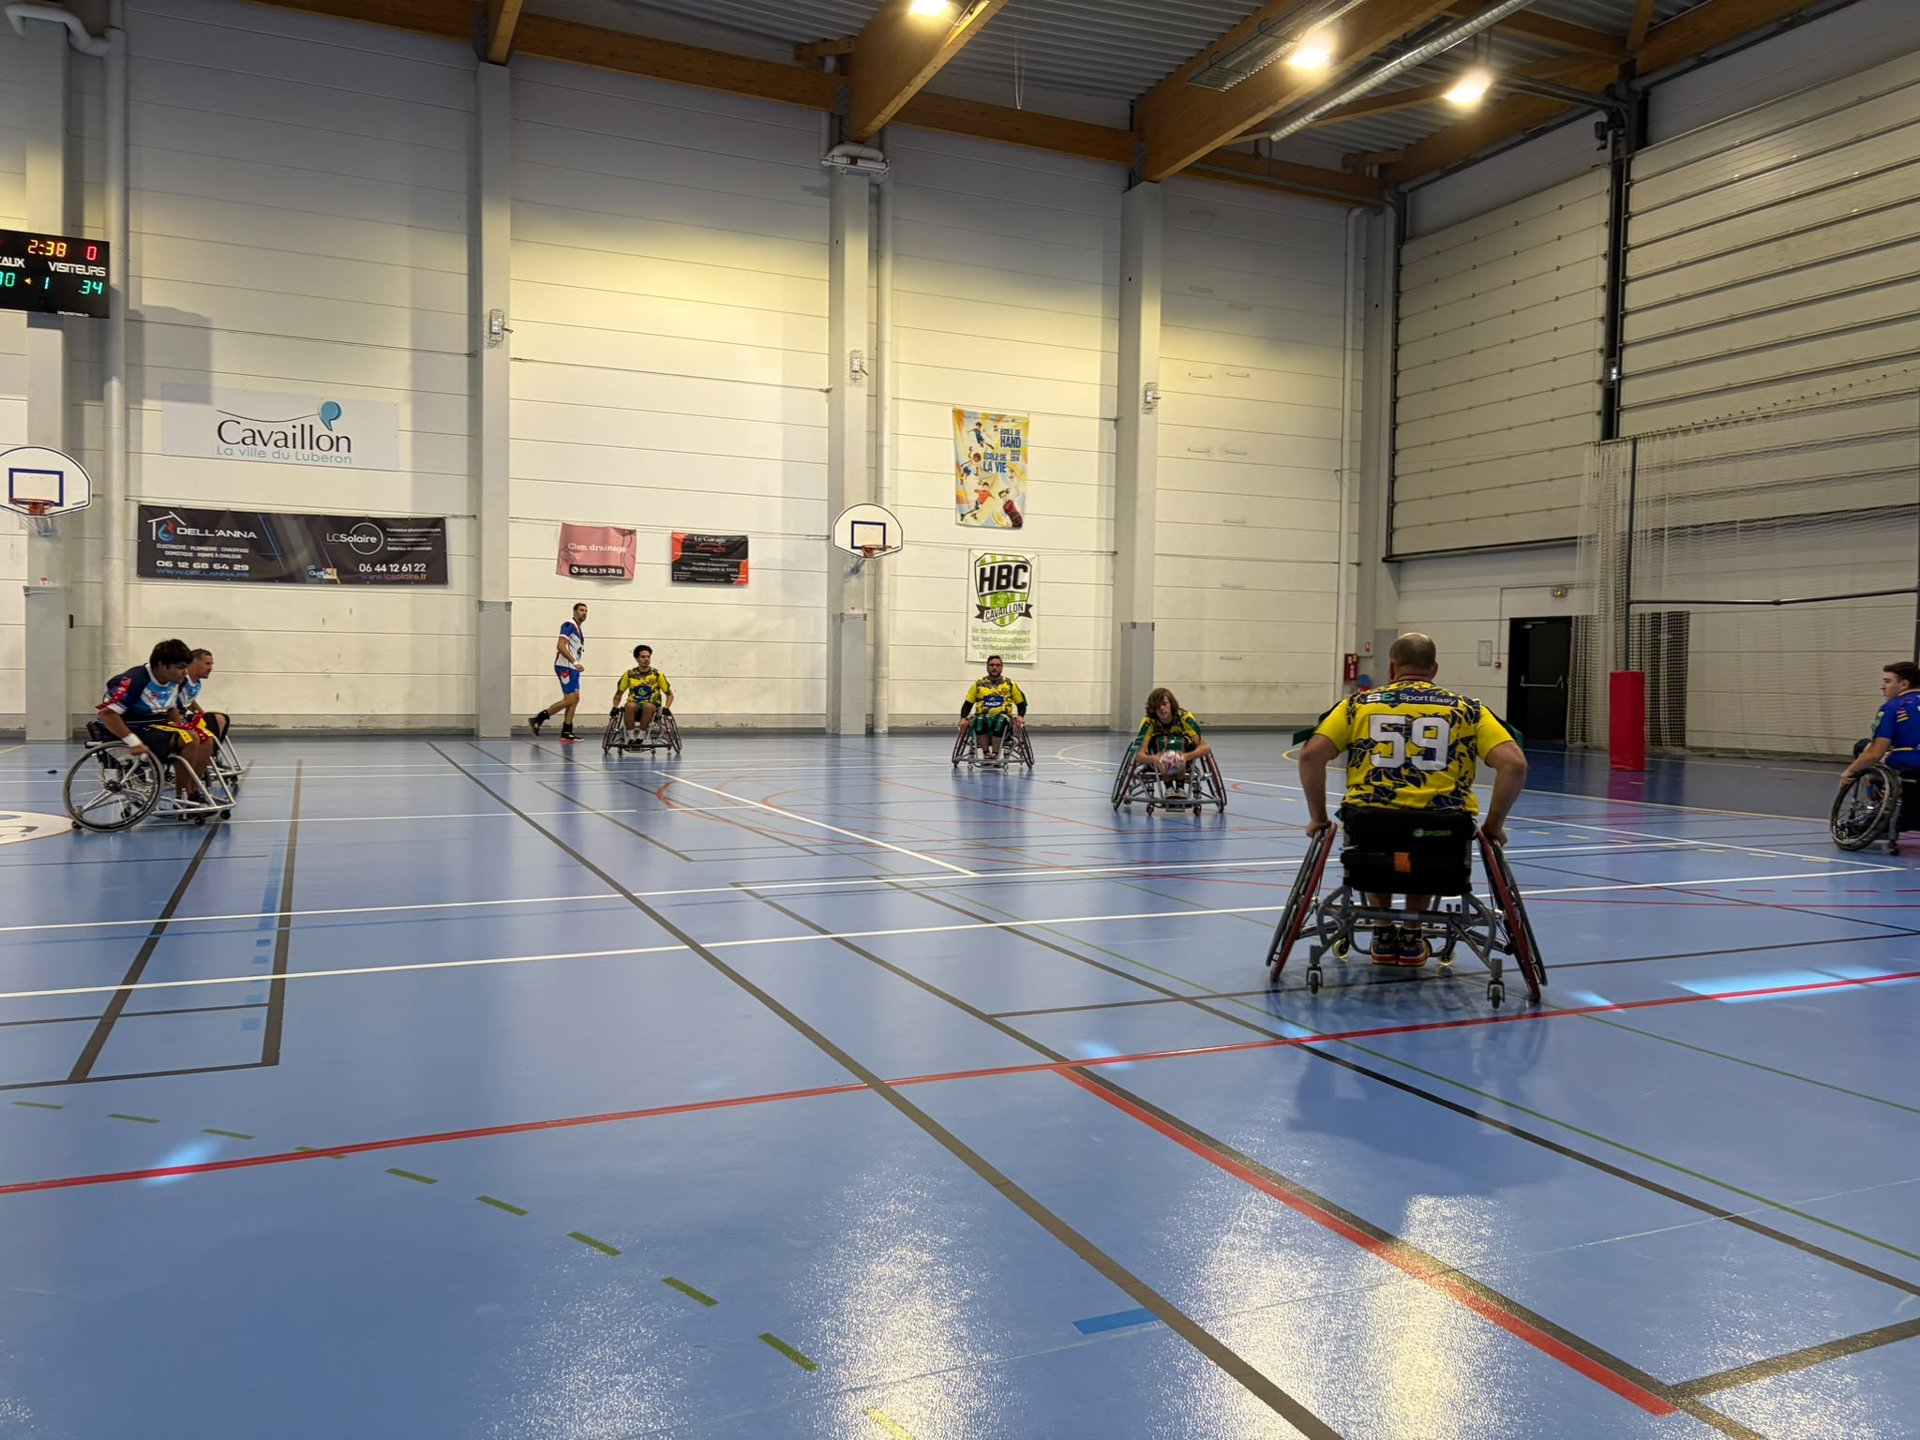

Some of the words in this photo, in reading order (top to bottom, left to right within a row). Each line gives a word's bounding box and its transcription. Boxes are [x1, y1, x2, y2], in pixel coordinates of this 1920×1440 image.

[28, 239, 67, 257] 2:38
[86, 246, 97, 260] 0
[48, 261, 106, 277] VISITEURS
[44, 276, 50, 290] 1
[79, 280, 103, 294] 34
[217, 419, 352, 453] Cavaillon
[1000, 436, 1021, 448] HAND
[217, 446, 233, 456] La
[239, 448, 266, 458] ville
[272, 450, 290, 460] du
[296, 450, 352, 464] Luberon
[983, 461, 993, 472] LA
[995, 462, 1007, 473] VIE
[176, 527, 258, 540] DELL'ANNA
[326, 532, 377, 544] LCSolaire
[590, 544, 627, 553] drainage
[358, 563, 372, 572] 06
[374, 564, 387, 572] 44
[389, 564, 399, 572] 12
[402, 564, 412, 572] 61
[414, 564, 426, 572] 22
[979, 564, 1028, 593] HBC
[986, 602, 1024, 620] CAVAILLON
[1400, 694, 1456, 705] SportEasy
[1370, 714, 1450, 770] 59
